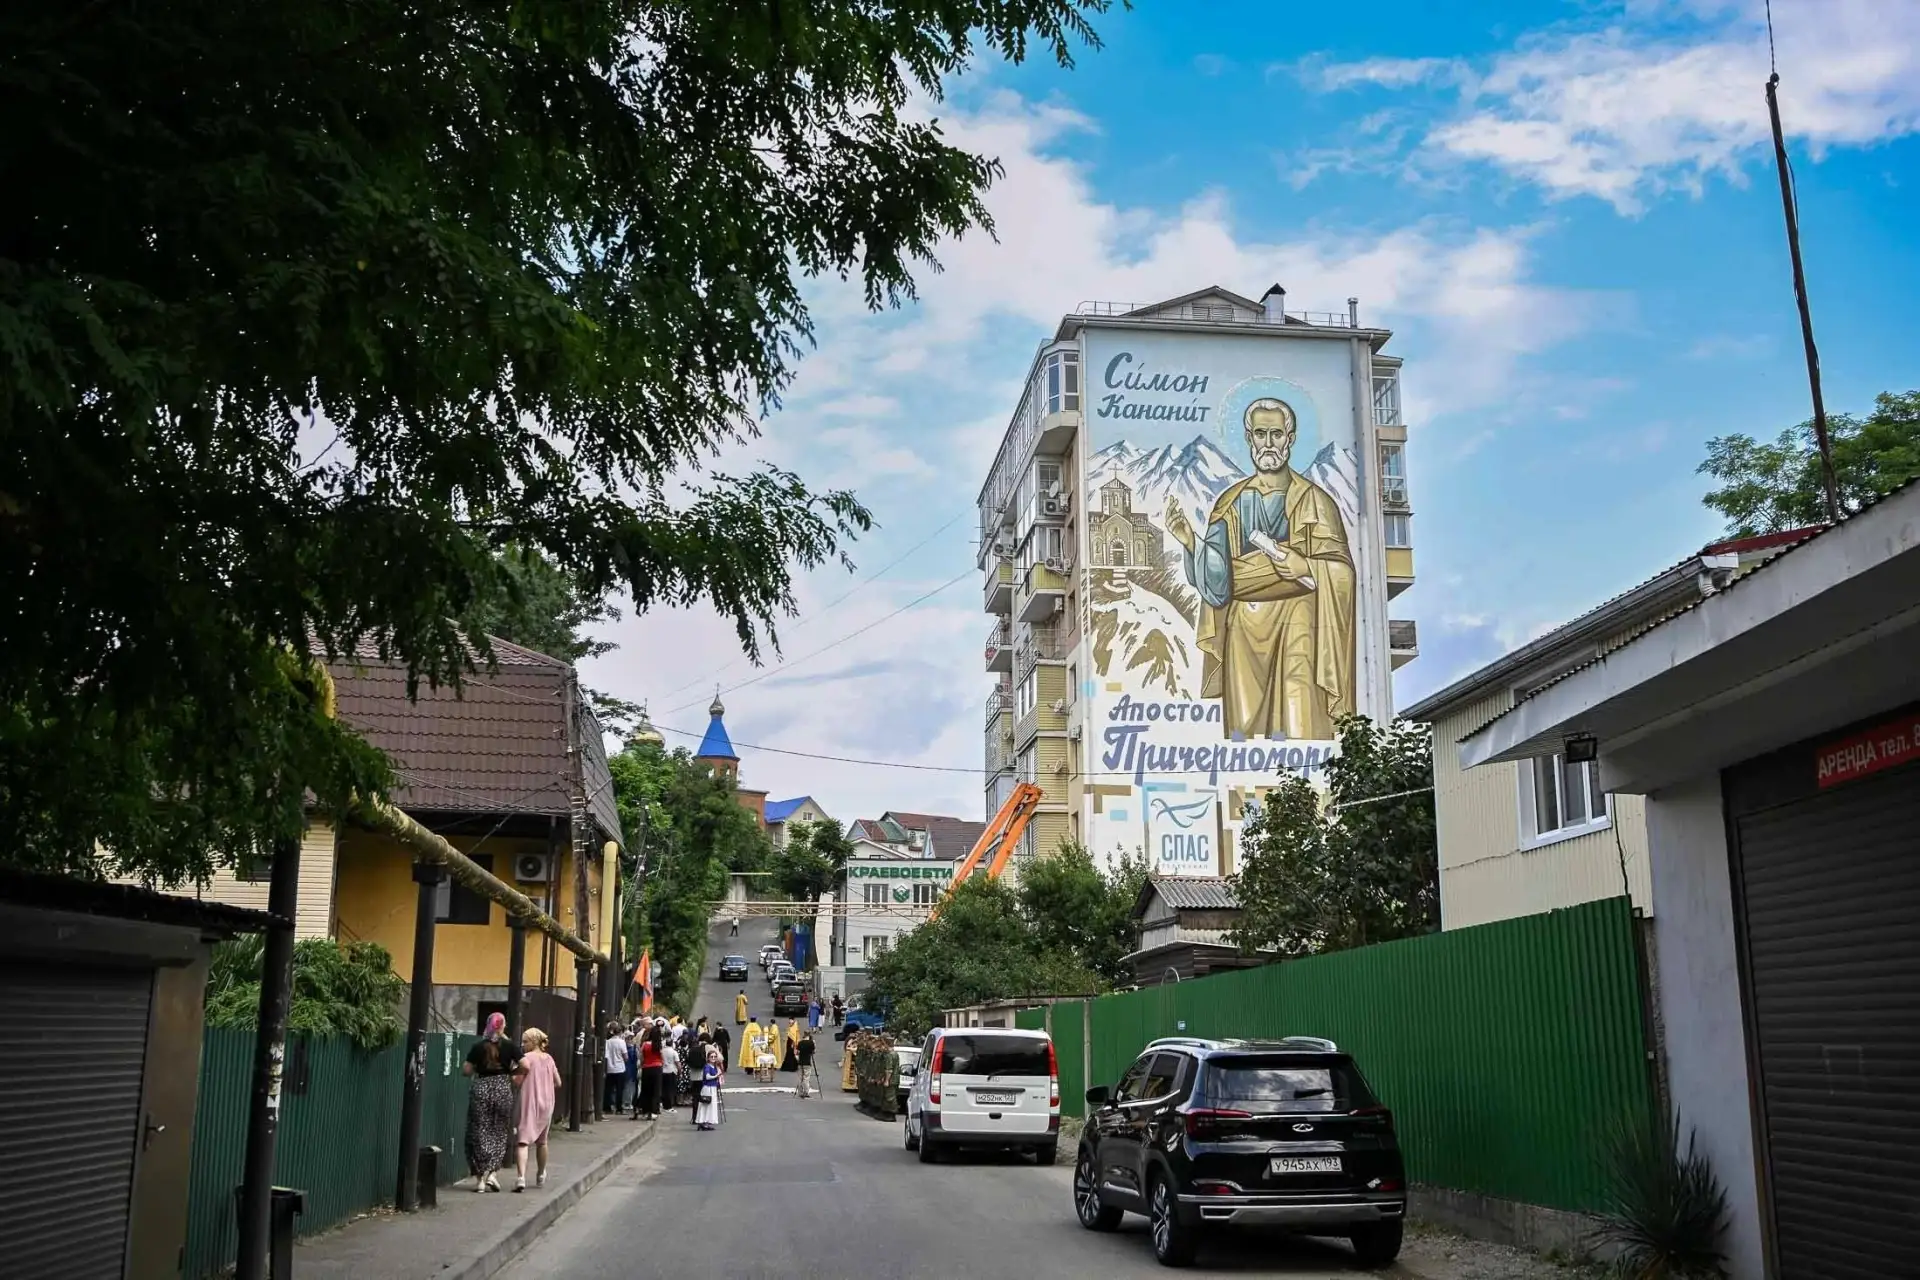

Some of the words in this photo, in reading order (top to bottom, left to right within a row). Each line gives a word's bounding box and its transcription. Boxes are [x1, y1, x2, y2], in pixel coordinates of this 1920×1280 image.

[1108, 694, 1221, 723] Апостол
[1818, 740, 1877, 779] АРЕНДА
[1879, 735, 1910, 759] тел.
[1161, 834, 1209, 861] СПАС
